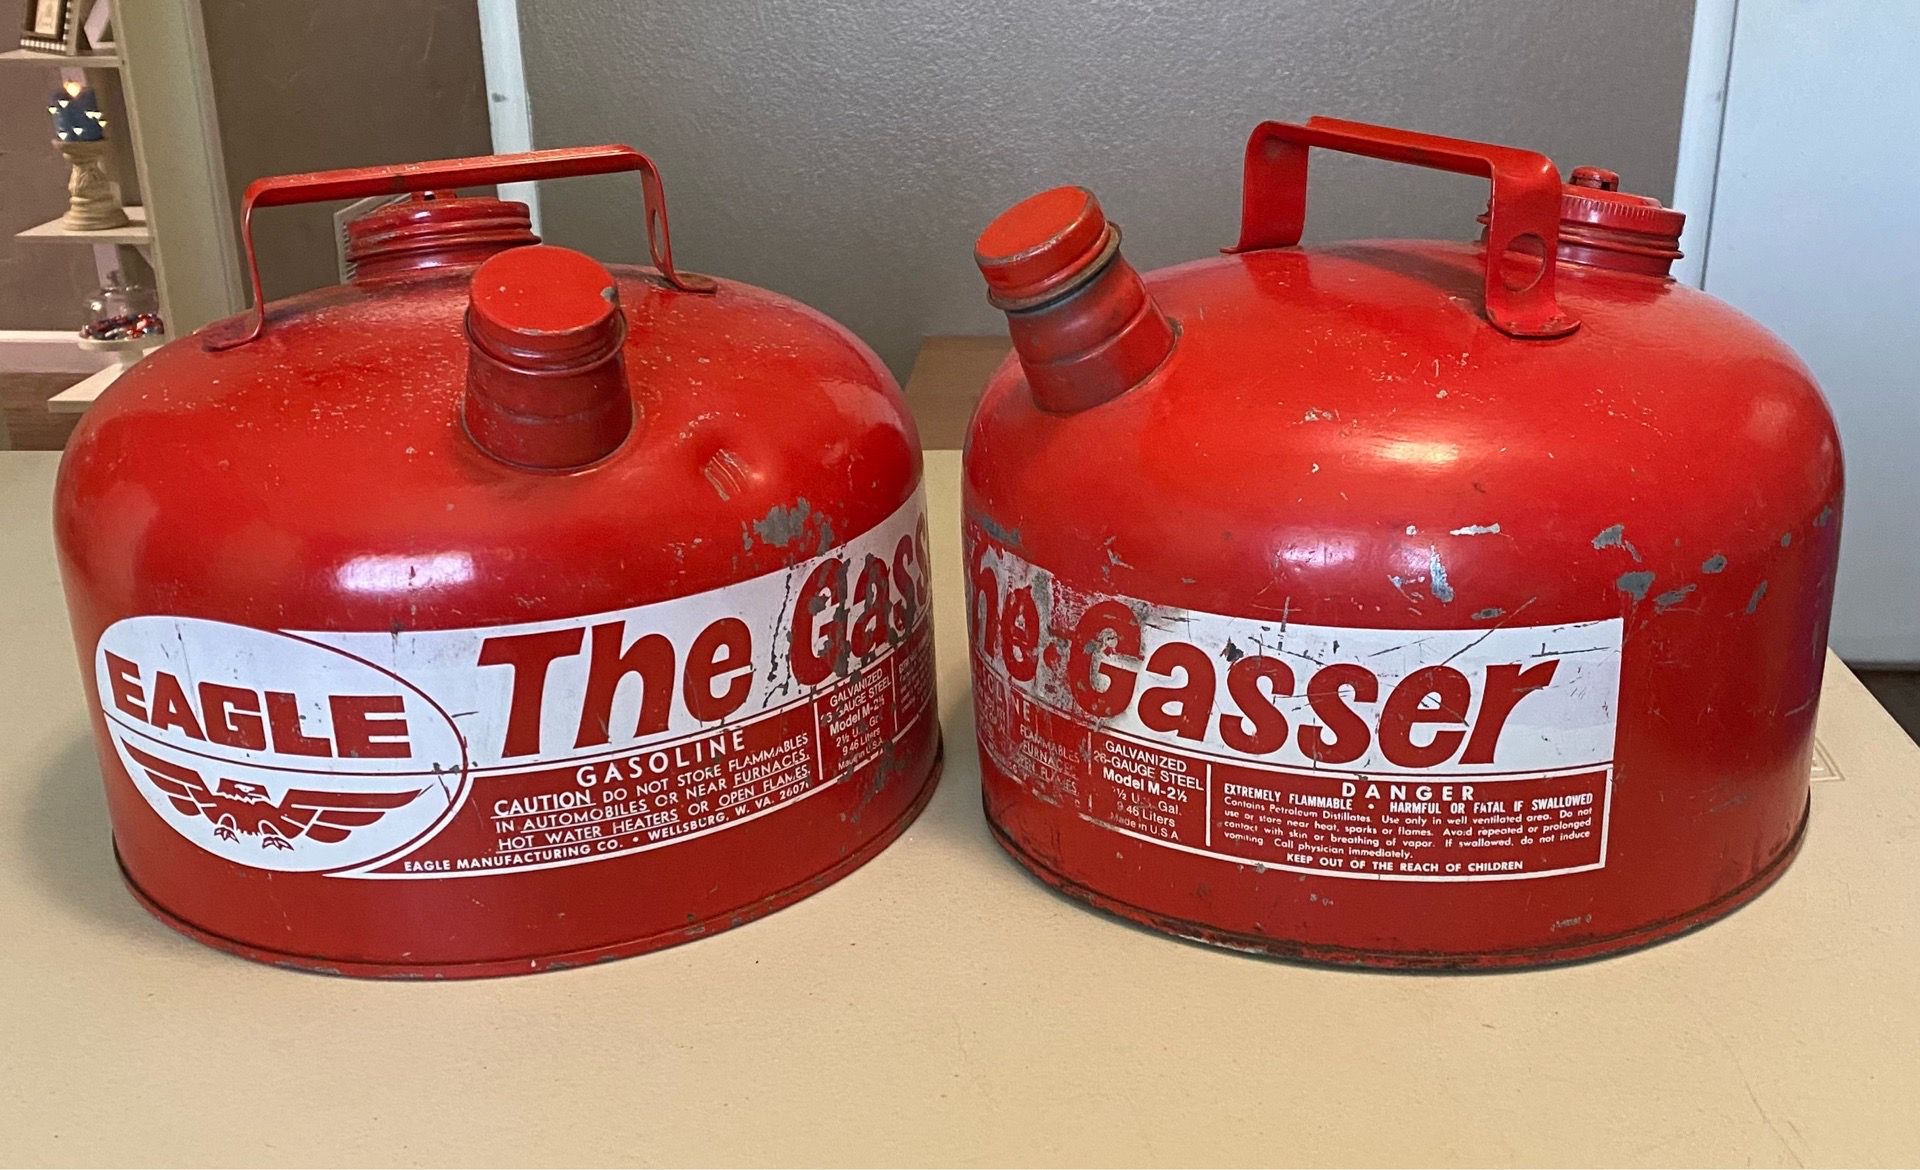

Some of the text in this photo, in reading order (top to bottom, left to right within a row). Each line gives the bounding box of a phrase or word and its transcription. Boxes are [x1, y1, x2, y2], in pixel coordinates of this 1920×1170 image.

[477, 617, 753, 758] The
[830, 668, 882, 707] GALVANIZED
[868, 676, 891, 698] STEEL
[1068, 601, 1560, 768] Gasser
[105, 649, 412, 758] EAGLE
[829, 709, 861, 736] Model
[576, 730, 745, 787] GASOLINE
[1094, 750, 1204, 791] 26-GAUGE STEEL
[1105, 740, 1187, 772] GALVANIZED
[494, 733, 808, 817] CAUTION DO NOT STORE FLAMMABLES
[1103, 767, 1187, 802] Model M-2½
[1342, 782, 1474, 801] DANGER
[496, 821, 514, 833] IN
[523, 799, 648, 830] AUTOMOBILES
[655, 793, 678, 807] OR
[686, 780, 727, 800] NEAR
[1224, 783, 1593, 814] EXTREMELY FLAMMABLE HARMFUL OR FATAL IF SWALLOWED
[1224, 796, 1265, 811] Contains
[1269, 804, 1318, 817] Petroleum
[1382, 815, 1400, 824] Use
[1405, 815, 1427, 827] only
[1432, 816, 1442, 825] in
[1447, 816, 1467, 825] well
[1472, 814, 1522, 825] ventilated
[1526, 813, 1552, 822] area.
[1560, 810, 1572, 818] Do
[1577, 807, 1592, 816] not
[404, 859, 450, 872] EAGLE
[457, 845, 590, 869] MANUFACTURING
[597, 838, 623, 851] CO.
[648, 812, 729, 841] WELLSBURG,
[734, 805, 750, 816] W.
[755, 798, 775, 809] VA.
[498, 835, 534, 850] HOT
[545, 826, 602, 844] WATER
[613, 810, 678, 834] HEATERS
[688, 801, 709, 815] OR
[719, 787, 754, 807] OPEN
[1142, 808, 1175, 827] Liters
[1224, 810, 1239, 818] use
[1244, 813, 1254, 821] or
[1259, 815, 1282, 825] store
[1287, 820, 1309, 828] near
[1345, 825, 1377, 834] sparks
[1443, 826, 1472, 836] Avoid
[1477, 825, 1523, 837] repeated
[1543, 817, 1591, 833] prolonged
[1224, 821, 1258, 832] contact
[1264, 827, 1284, 836] with
[1289, 829, 1308, 839] skin
[1314, 834, 1324, 842] or
[1331, 834, 1379, 847] breathing
[1385, 838, 1396, 847] of
[1445, 838, 1453, 847] If
[1520, 836, 1533, 845] do
[1539, 835, 1555, 843] not
[1560, 830, 1590, 841] induce
[1274, 838, 1294, 848] Call
[1298, 842, 1344, 853] physician
[1349, 847, 1413, 859] immediately.
[1286, 853, 1523, 872] KEEP OUT OF THE REACH OF CHILDREN
